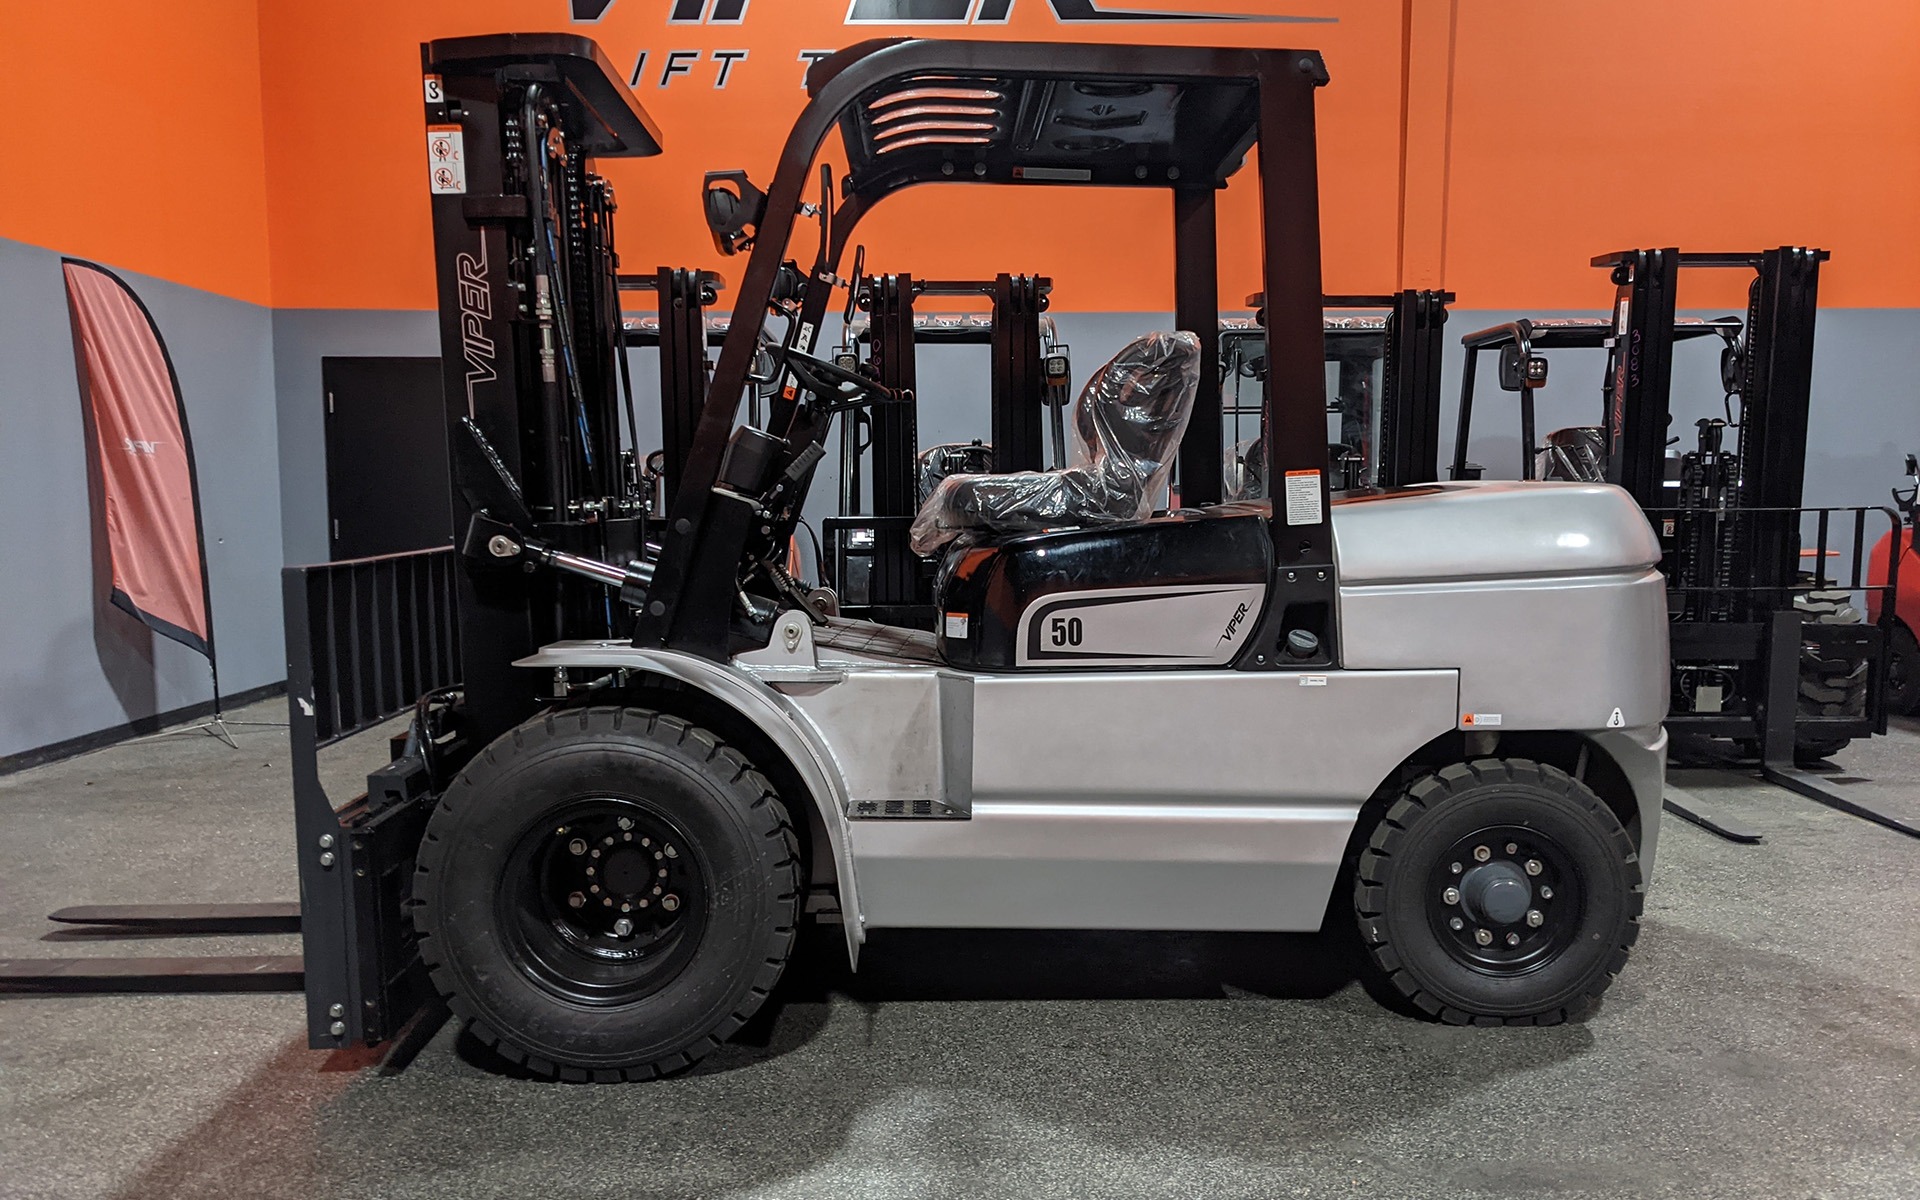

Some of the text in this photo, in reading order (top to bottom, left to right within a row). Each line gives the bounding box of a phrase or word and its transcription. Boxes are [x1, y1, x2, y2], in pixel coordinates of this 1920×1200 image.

[629, 49, 749, 89] IFT
[456, 240, 497, 396] VIPER
[1052, 617, 1083, 646] 50
[1219, 600, 1252, 645] VIPER
